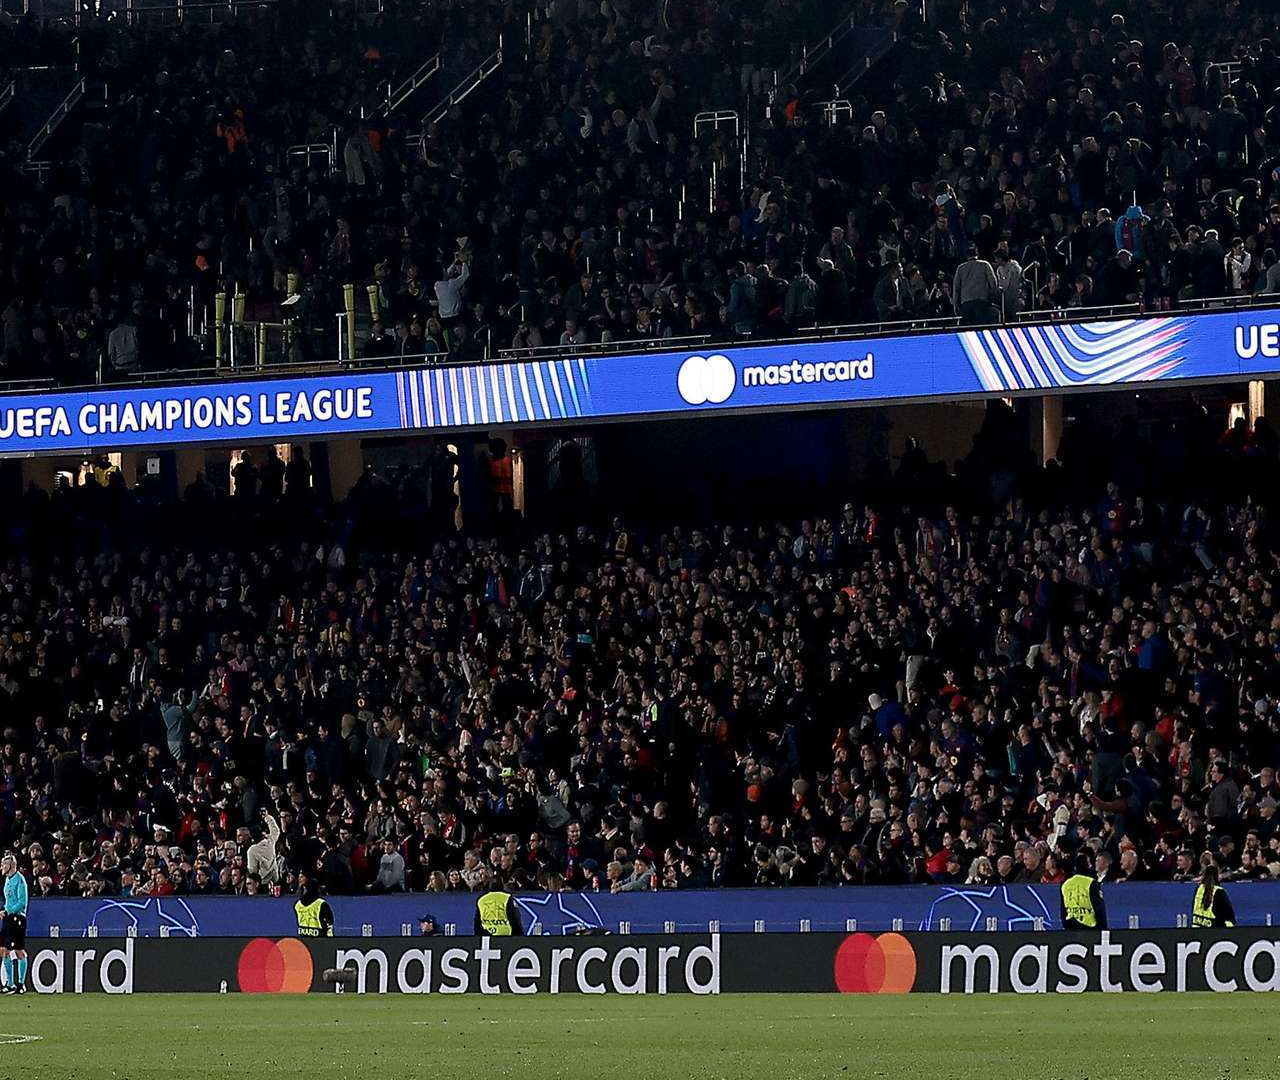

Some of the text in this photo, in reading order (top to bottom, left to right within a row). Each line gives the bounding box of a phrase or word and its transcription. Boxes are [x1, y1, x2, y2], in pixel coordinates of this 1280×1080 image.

[743, 352, 873, 387] mastercard
[79, 395, 252, 433] CHAMPIONS
[260, 387, 373, 424] LEAGUE
[335, 933, 720, 994] mastercard
